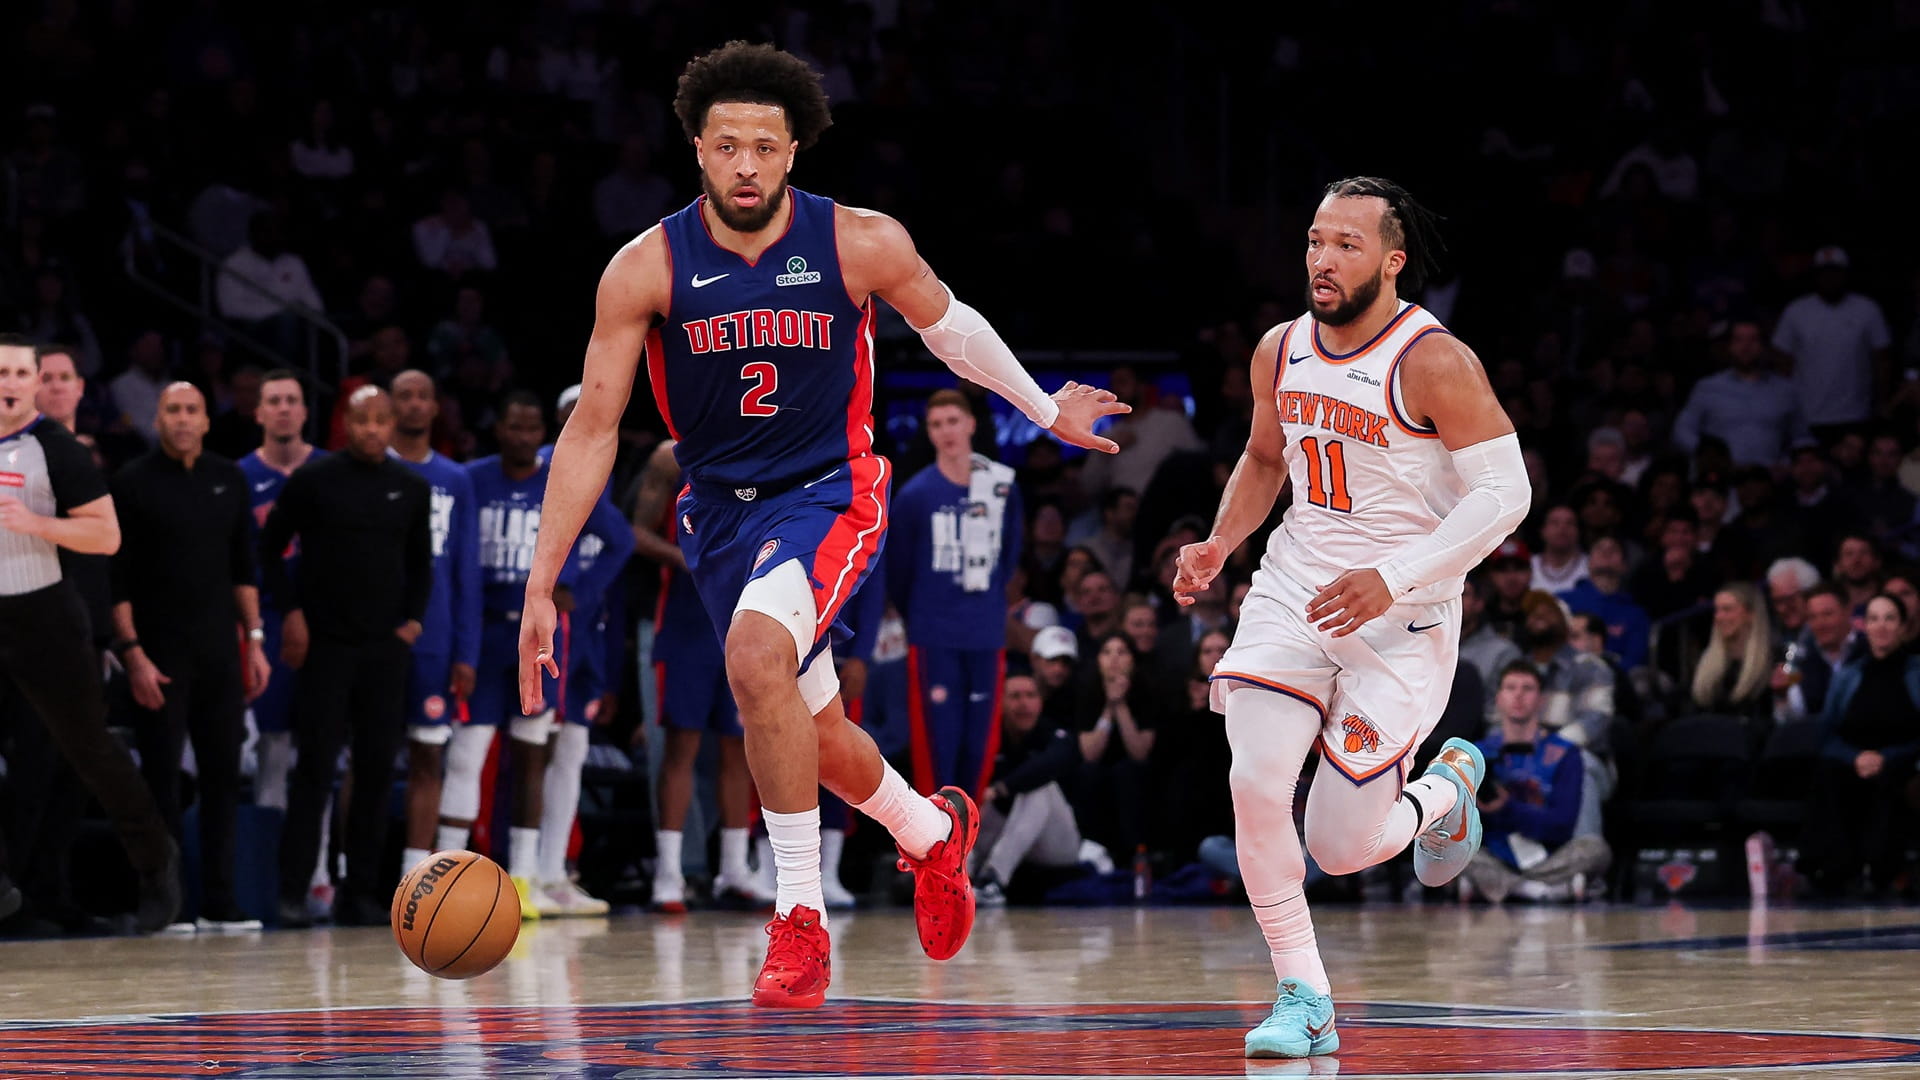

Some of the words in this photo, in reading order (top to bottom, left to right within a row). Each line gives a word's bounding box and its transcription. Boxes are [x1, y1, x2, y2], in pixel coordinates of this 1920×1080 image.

[777, 273, 820, 285] StockX
[682, 309, 834, 354] DETROIT
[740, 361, 779, 417] 2
[1278, 390, 1320, 426] NEW
[1321, 393, 1389, 448] YORK
[1300, 436, 1352, 513] 11
[1341, 714, 1380, 753] KNICKS
[402, 857, 460, 931] Wilson
